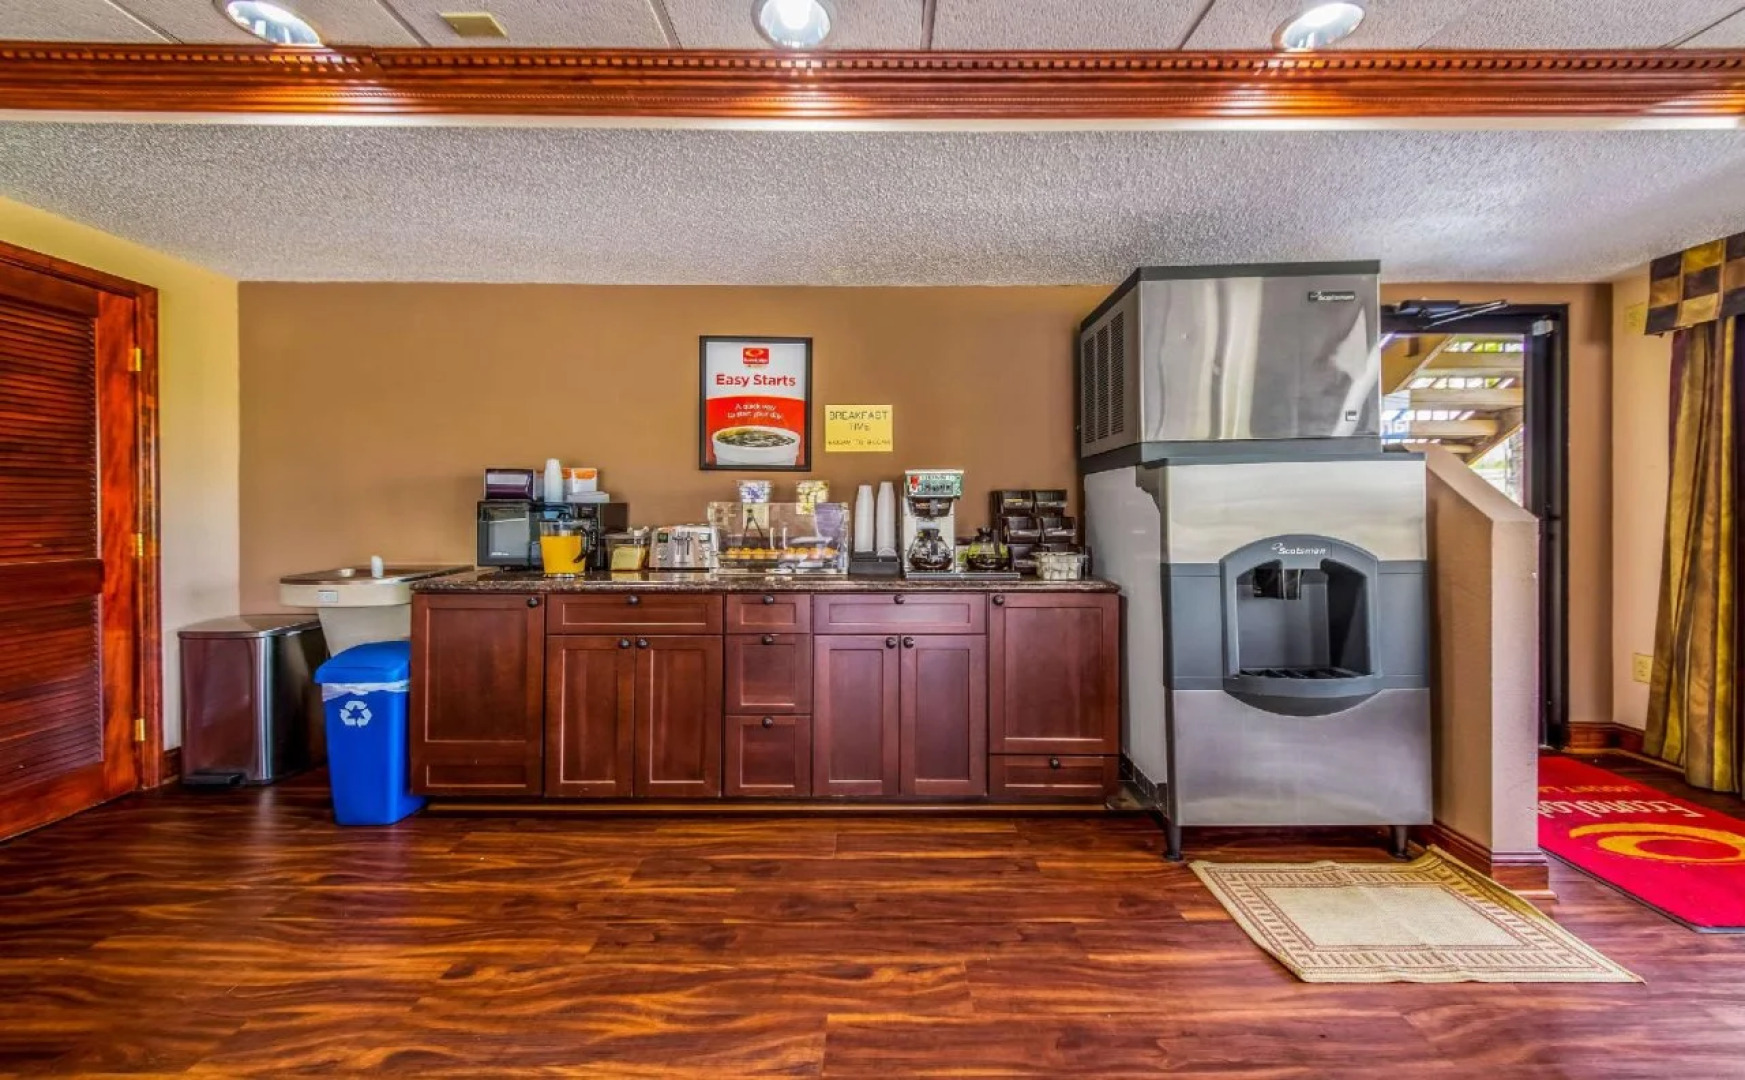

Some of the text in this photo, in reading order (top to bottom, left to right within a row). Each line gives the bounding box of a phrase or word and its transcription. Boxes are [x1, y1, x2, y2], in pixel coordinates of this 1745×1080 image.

[715, 374, 796, 387] Easy Starts
[829, 411, 888, 420] BREAKFAST
[1278, 547, 1326, 555] Scotsman
